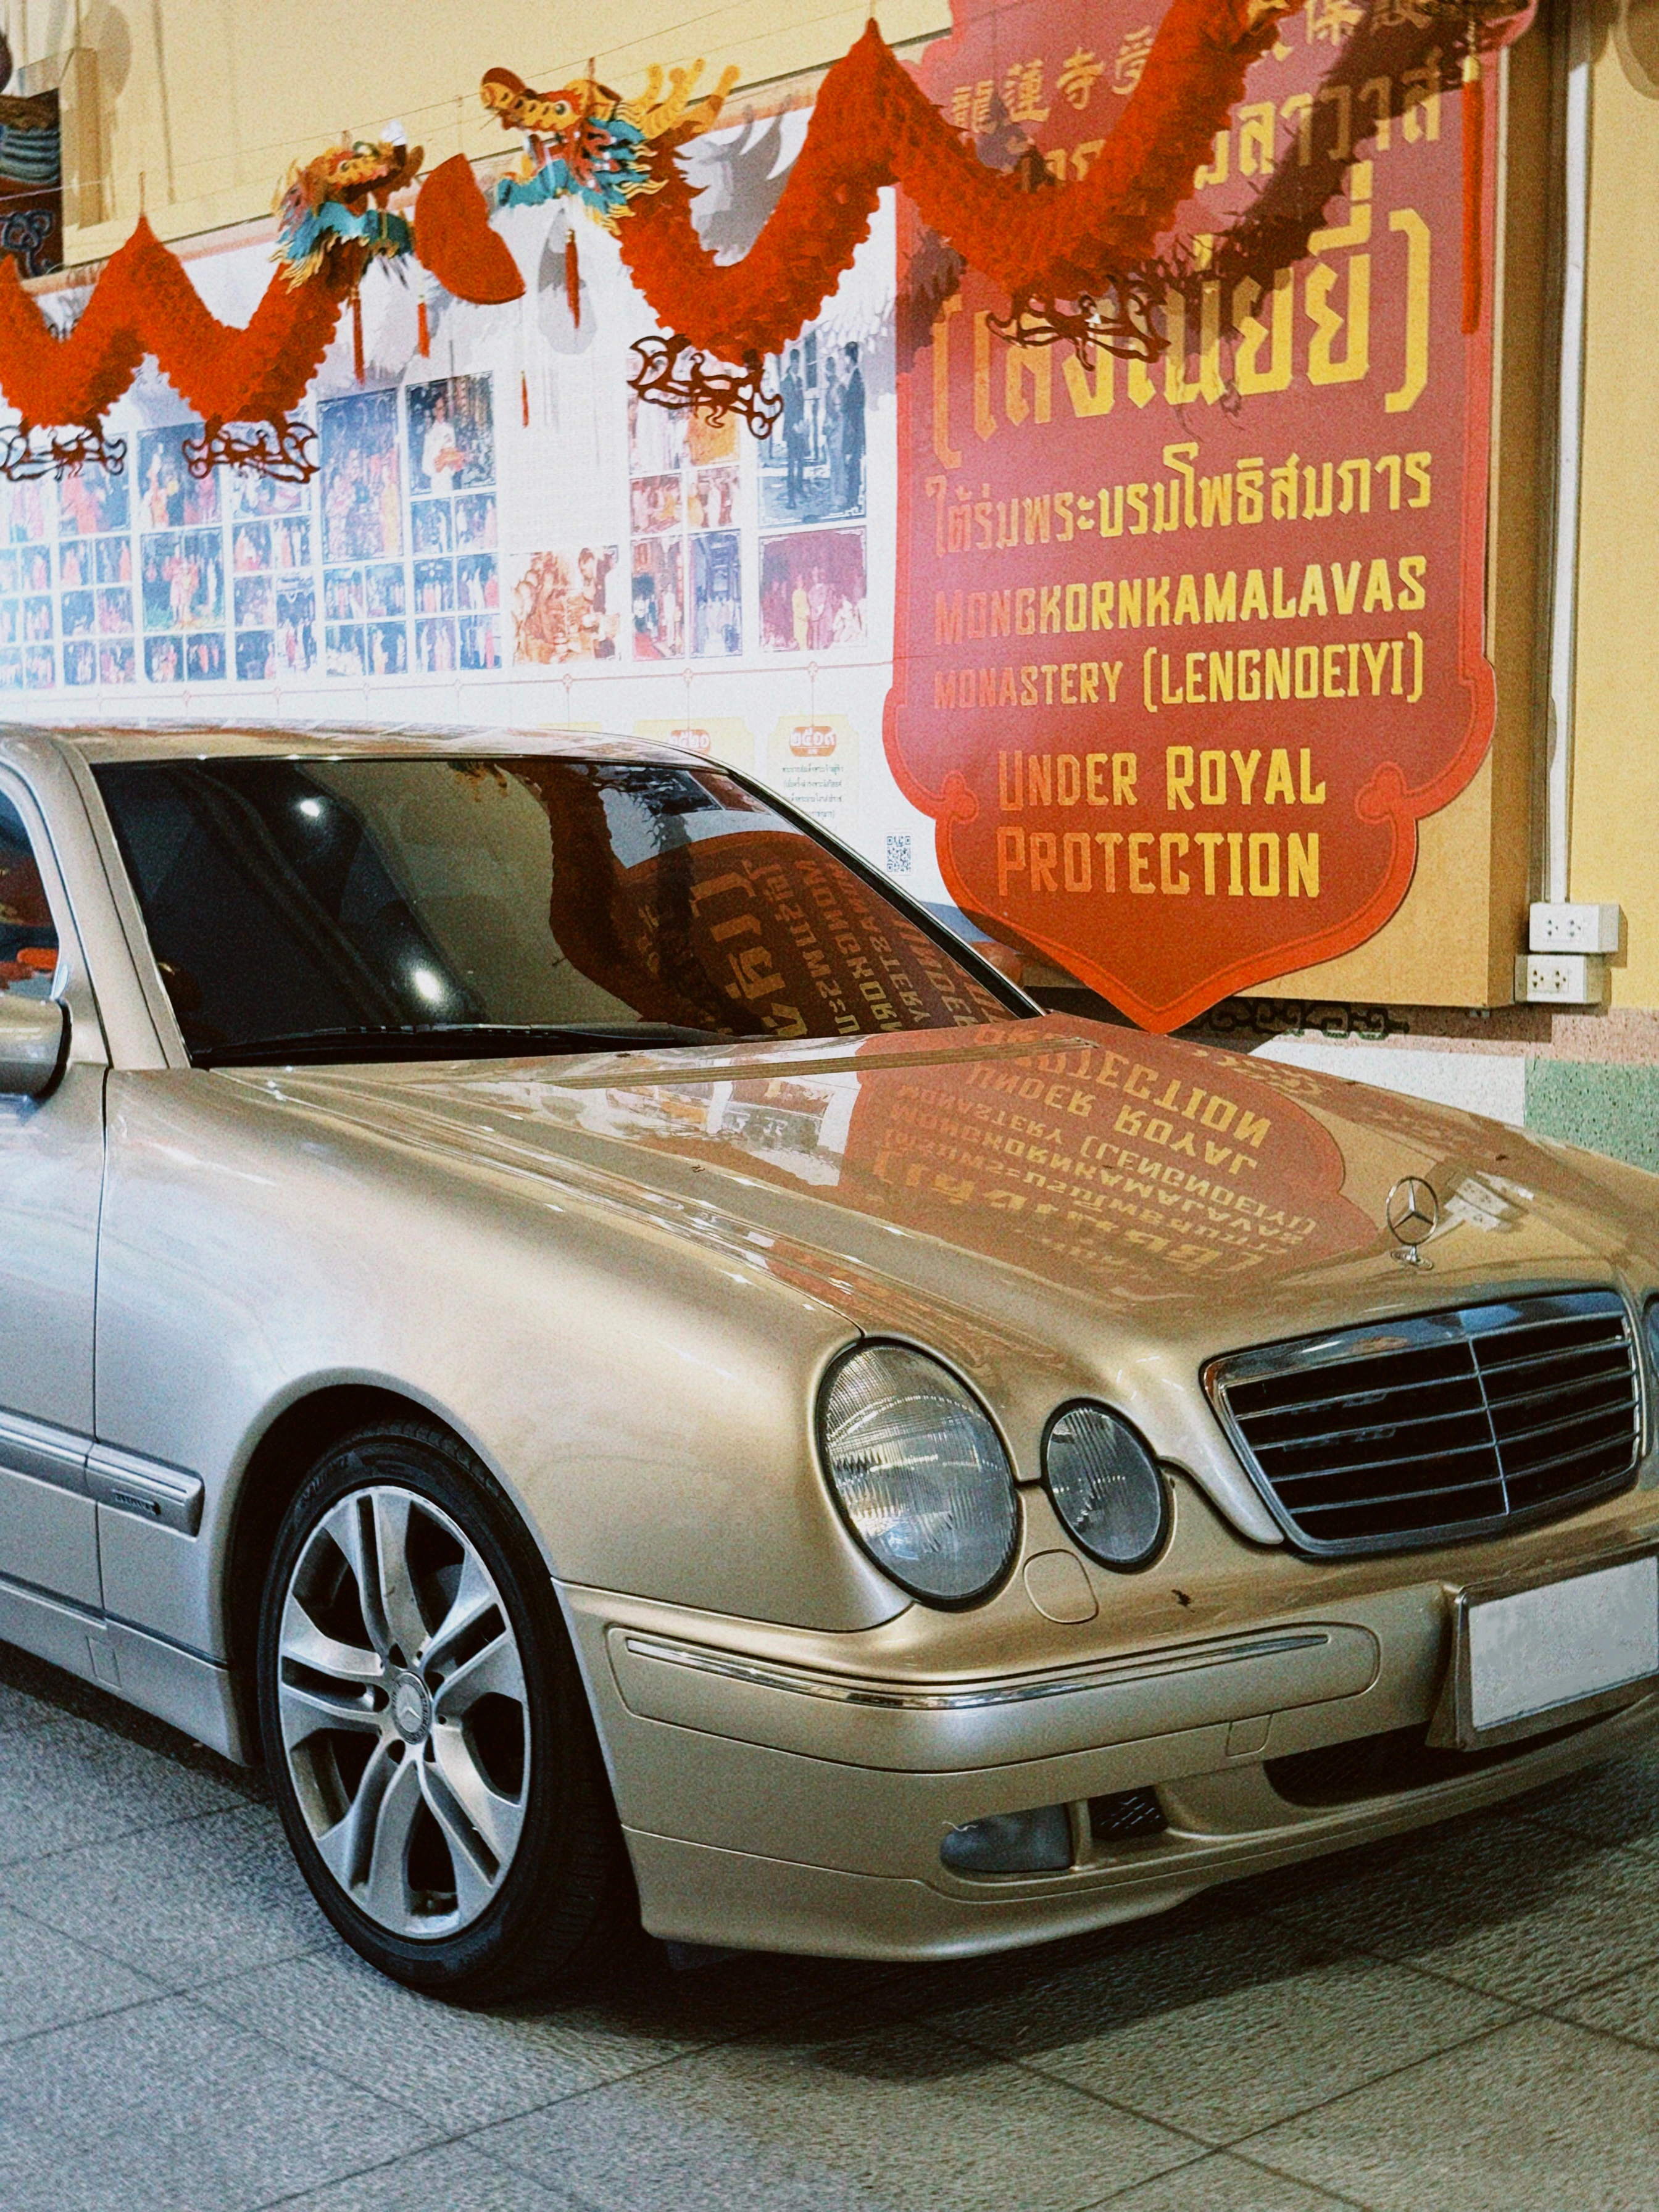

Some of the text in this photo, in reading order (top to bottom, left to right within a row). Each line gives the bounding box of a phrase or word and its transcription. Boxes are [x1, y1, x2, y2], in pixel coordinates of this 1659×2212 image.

[934, 555, 1427, 645] MONGKORNKAMALAVAS
[934, 632, 1424, 712] MONASTERY (LENGNOEIYI)
[998, 746, 1326, 812] UNDER ROYAL
[997, 826, 1320, 898] PROTECTION
